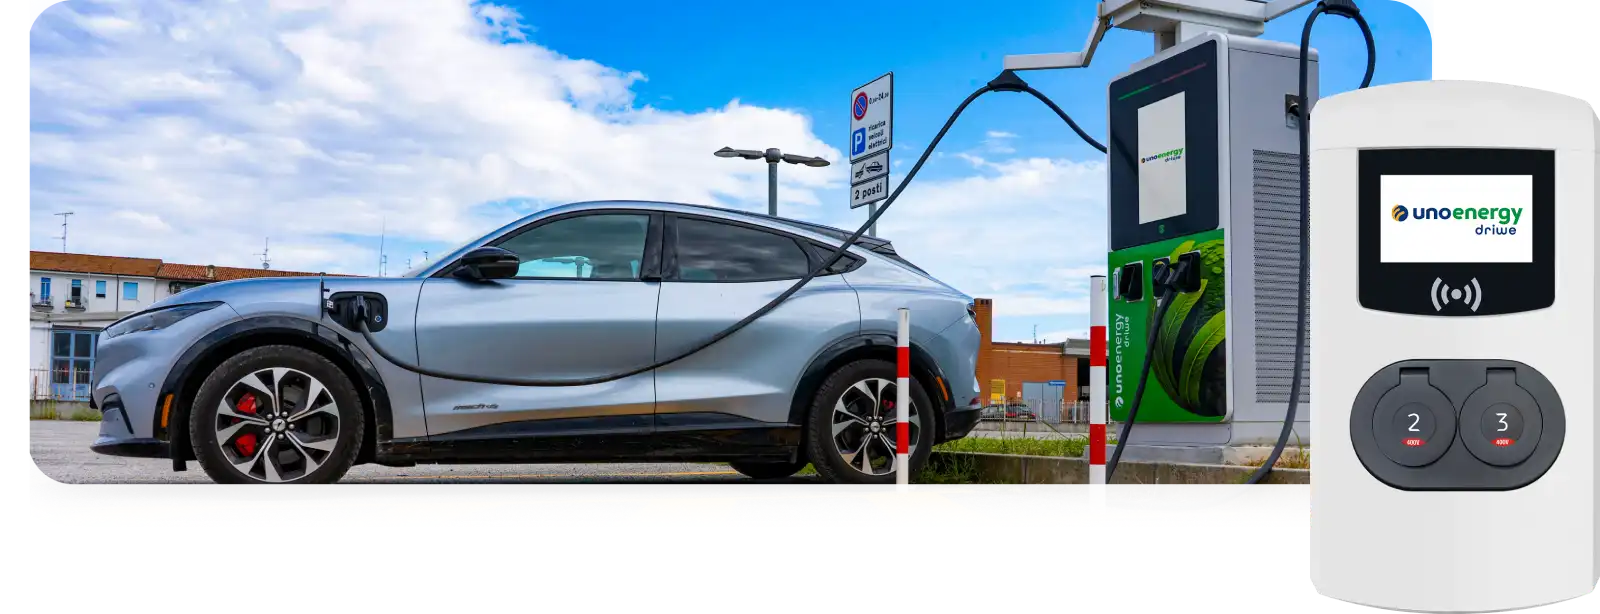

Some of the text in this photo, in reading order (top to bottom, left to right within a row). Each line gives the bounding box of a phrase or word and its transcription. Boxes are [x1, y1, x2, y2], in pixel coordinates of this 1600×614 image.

[868, 120, 886, 131] ricarica
[868, 129, 884, 140] veicoli
[868, 137, 887, 149] elettrici
[1146, 148, 1184, 161] unoenergy
[855, 183, 882, 200] 2 posti
[1413, 207, 1523, 225] unoenergy
[1475, 224, 1517, 235] driwe
[1116, 314, 1124, 393] unoenergy
[1408, 413, 1420, 431] 2
[1496, 412, 1508, 431] 3
